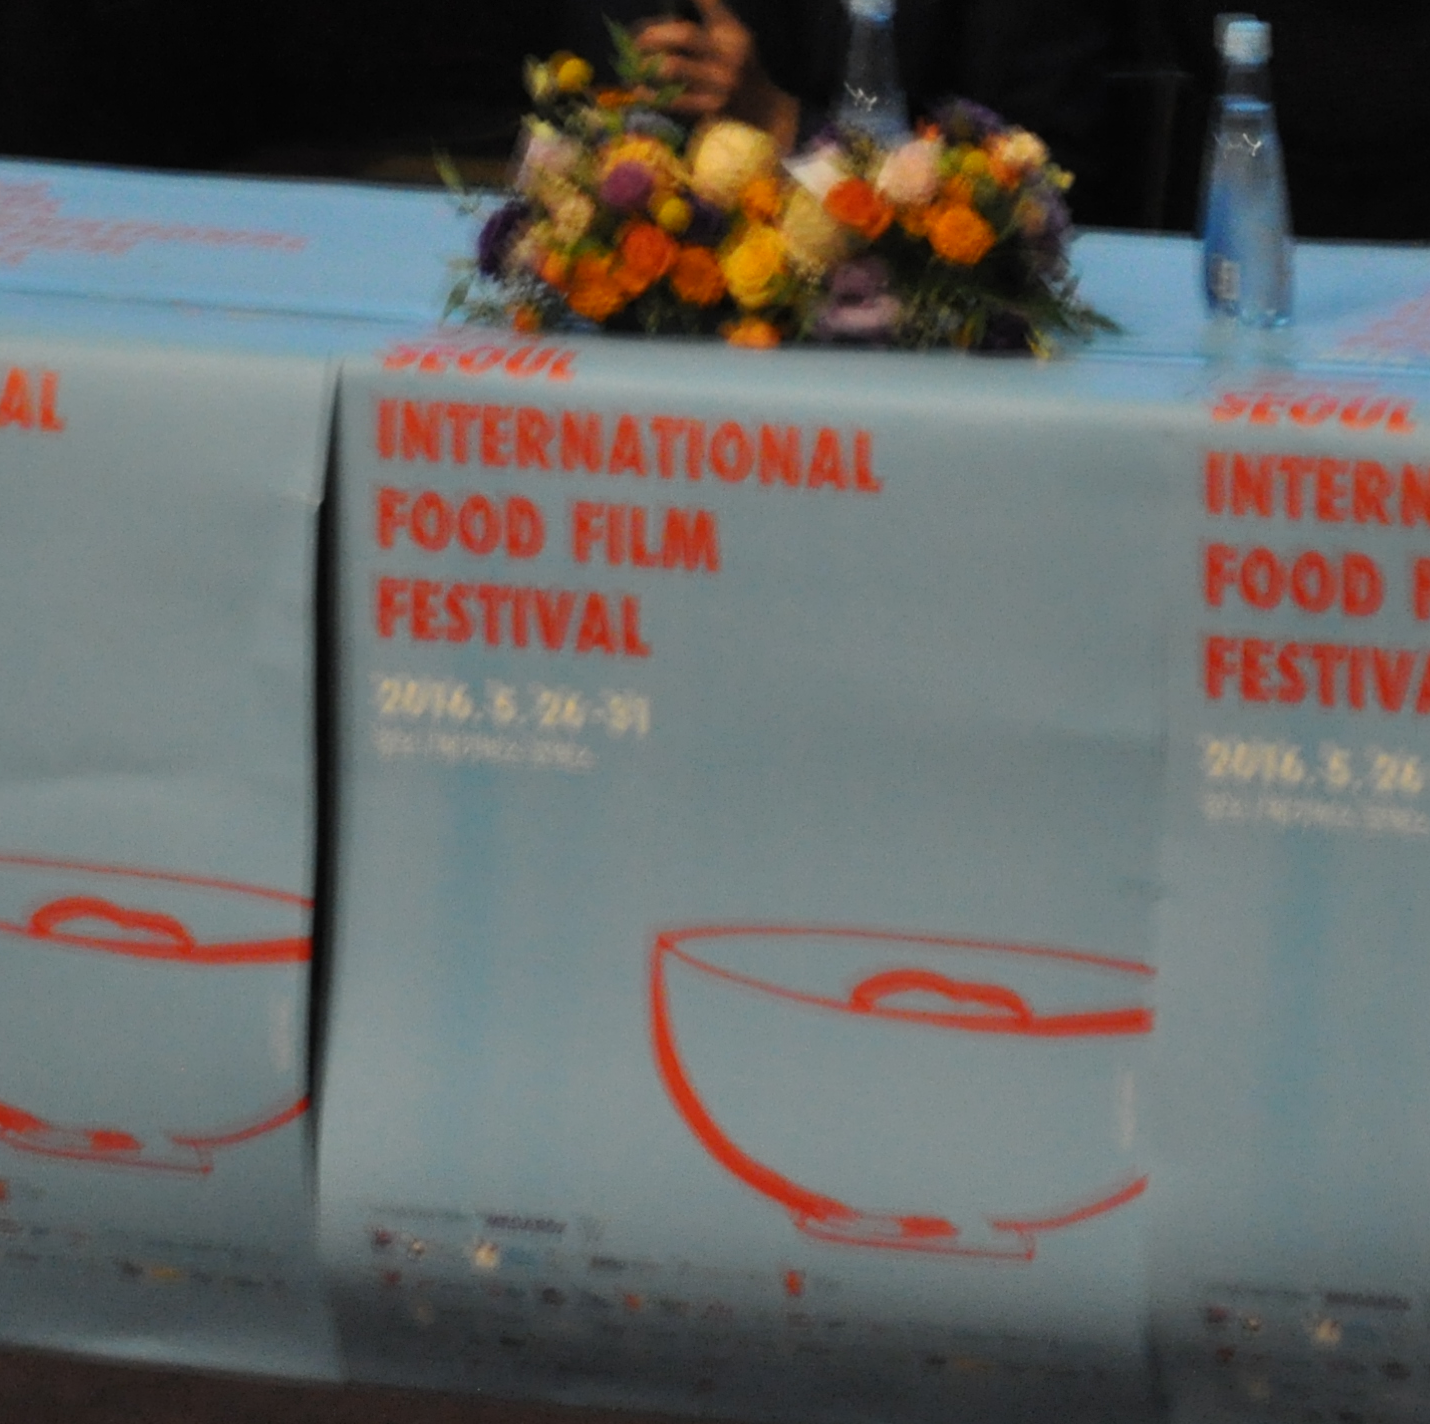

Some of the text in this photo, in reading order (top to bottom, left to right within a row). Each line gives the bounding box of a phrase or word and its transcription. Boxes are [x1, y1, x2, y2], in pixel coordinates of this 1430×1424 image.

[375, 396, 884, 493] INTERNATIONAL
[375, 485, 722, 573] FOOD FILM
[375, 574, 652, 659] FESTIVAL
[1201, 541, 1386, 619] FOOD
